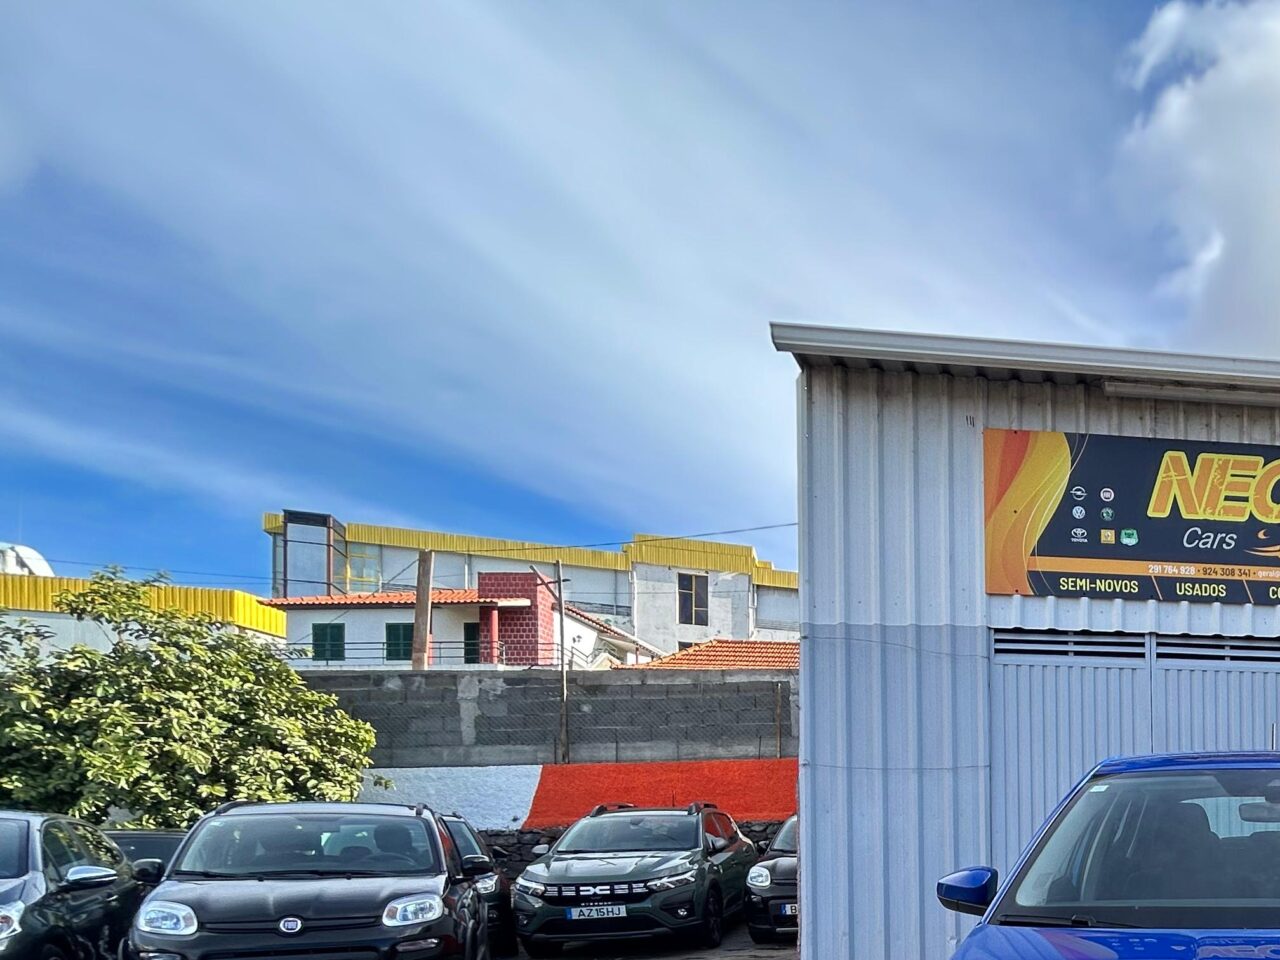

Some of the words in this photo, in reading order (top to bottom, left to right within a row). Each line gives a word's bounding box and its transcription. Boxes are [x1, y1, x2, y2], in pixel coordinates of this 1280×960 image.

[1182, 526, 1238, 550] Cars
[1202, 568, 1218, 577] 924
[1219, 568, 1236, 577] 308
[1237, 569, 1251, 578] 341
[1059, 577, 1139, 593] SEMI-NOVOS
[1176, 582, 1227, 597] USADOS
